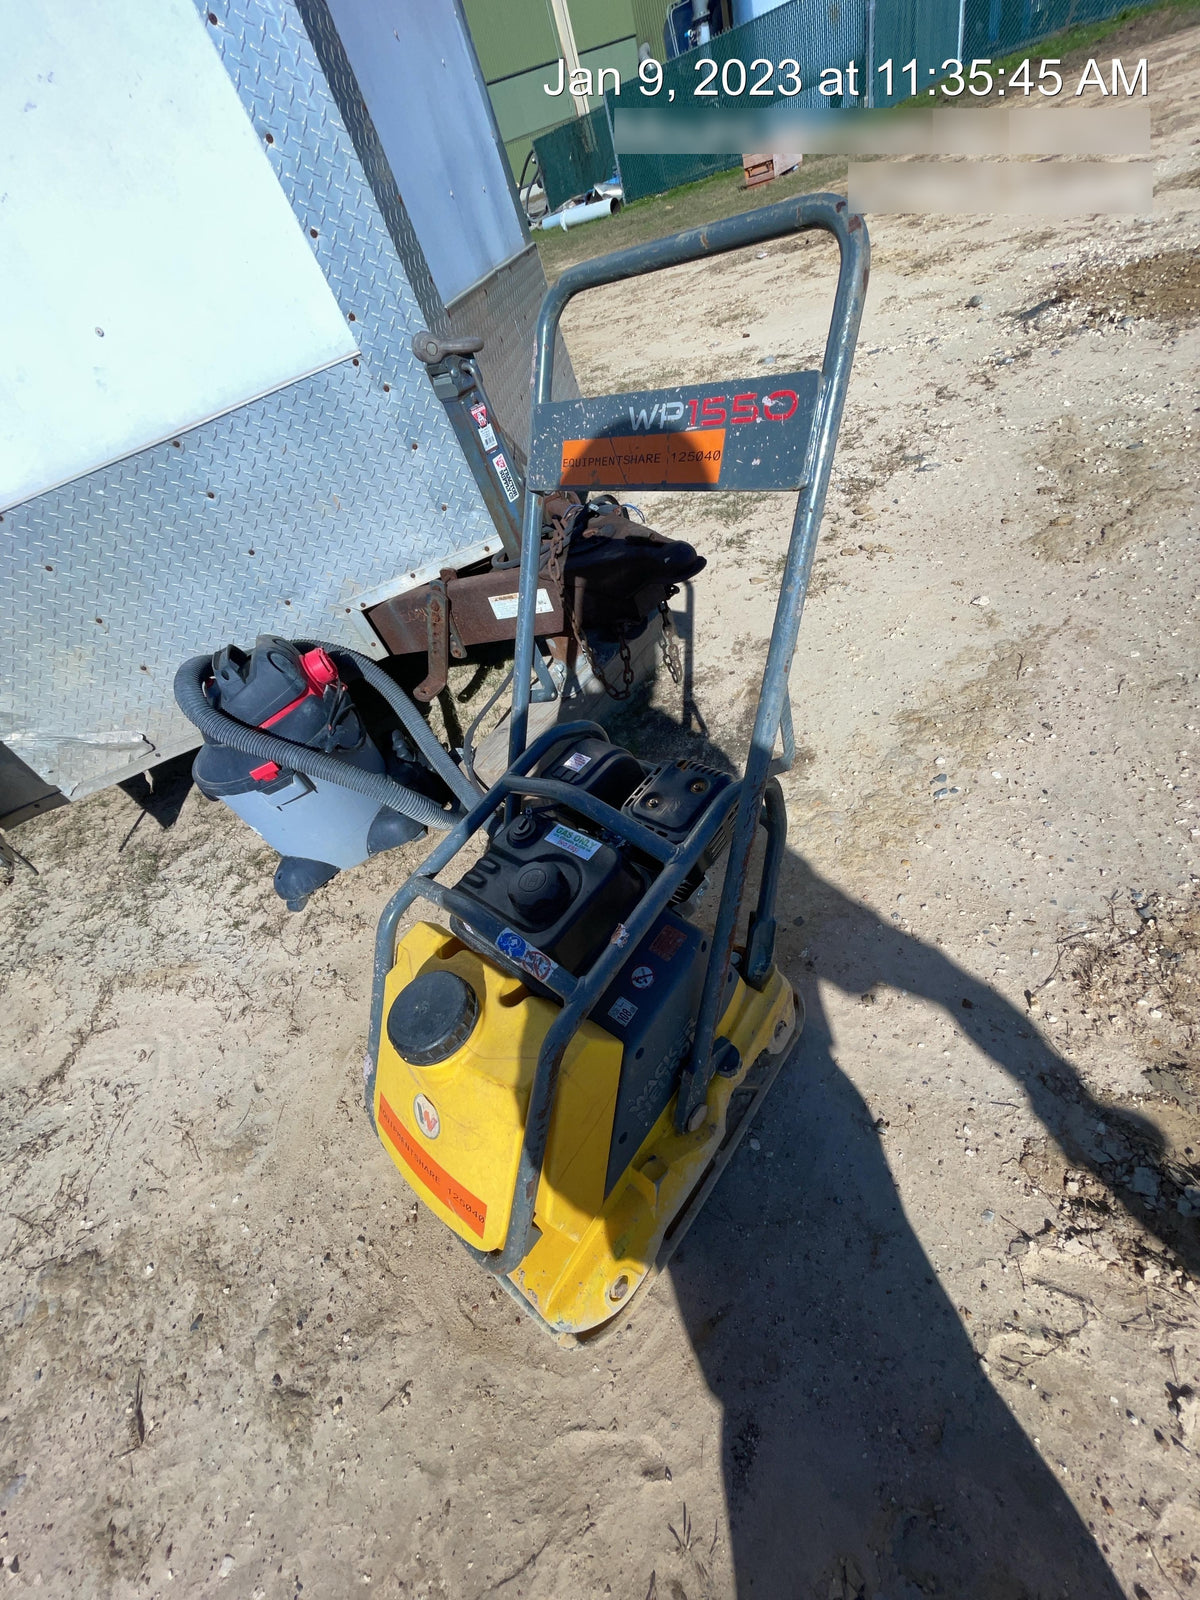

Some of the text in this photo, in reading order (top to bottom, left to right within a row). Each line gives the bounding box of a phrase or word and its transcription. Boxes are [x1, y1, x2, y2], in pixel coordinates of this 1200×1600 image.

[629, 389, 799, 432] WP1550
[563, 450, 721, 468] EQUIPMENTSHARE 125040
[503, 466, 518, 497] TRACTOR
[556, 827, 573, 838] GAS
[574, 834, 597, 848] ONLY
[617, 1009, 632, 1023] 108
